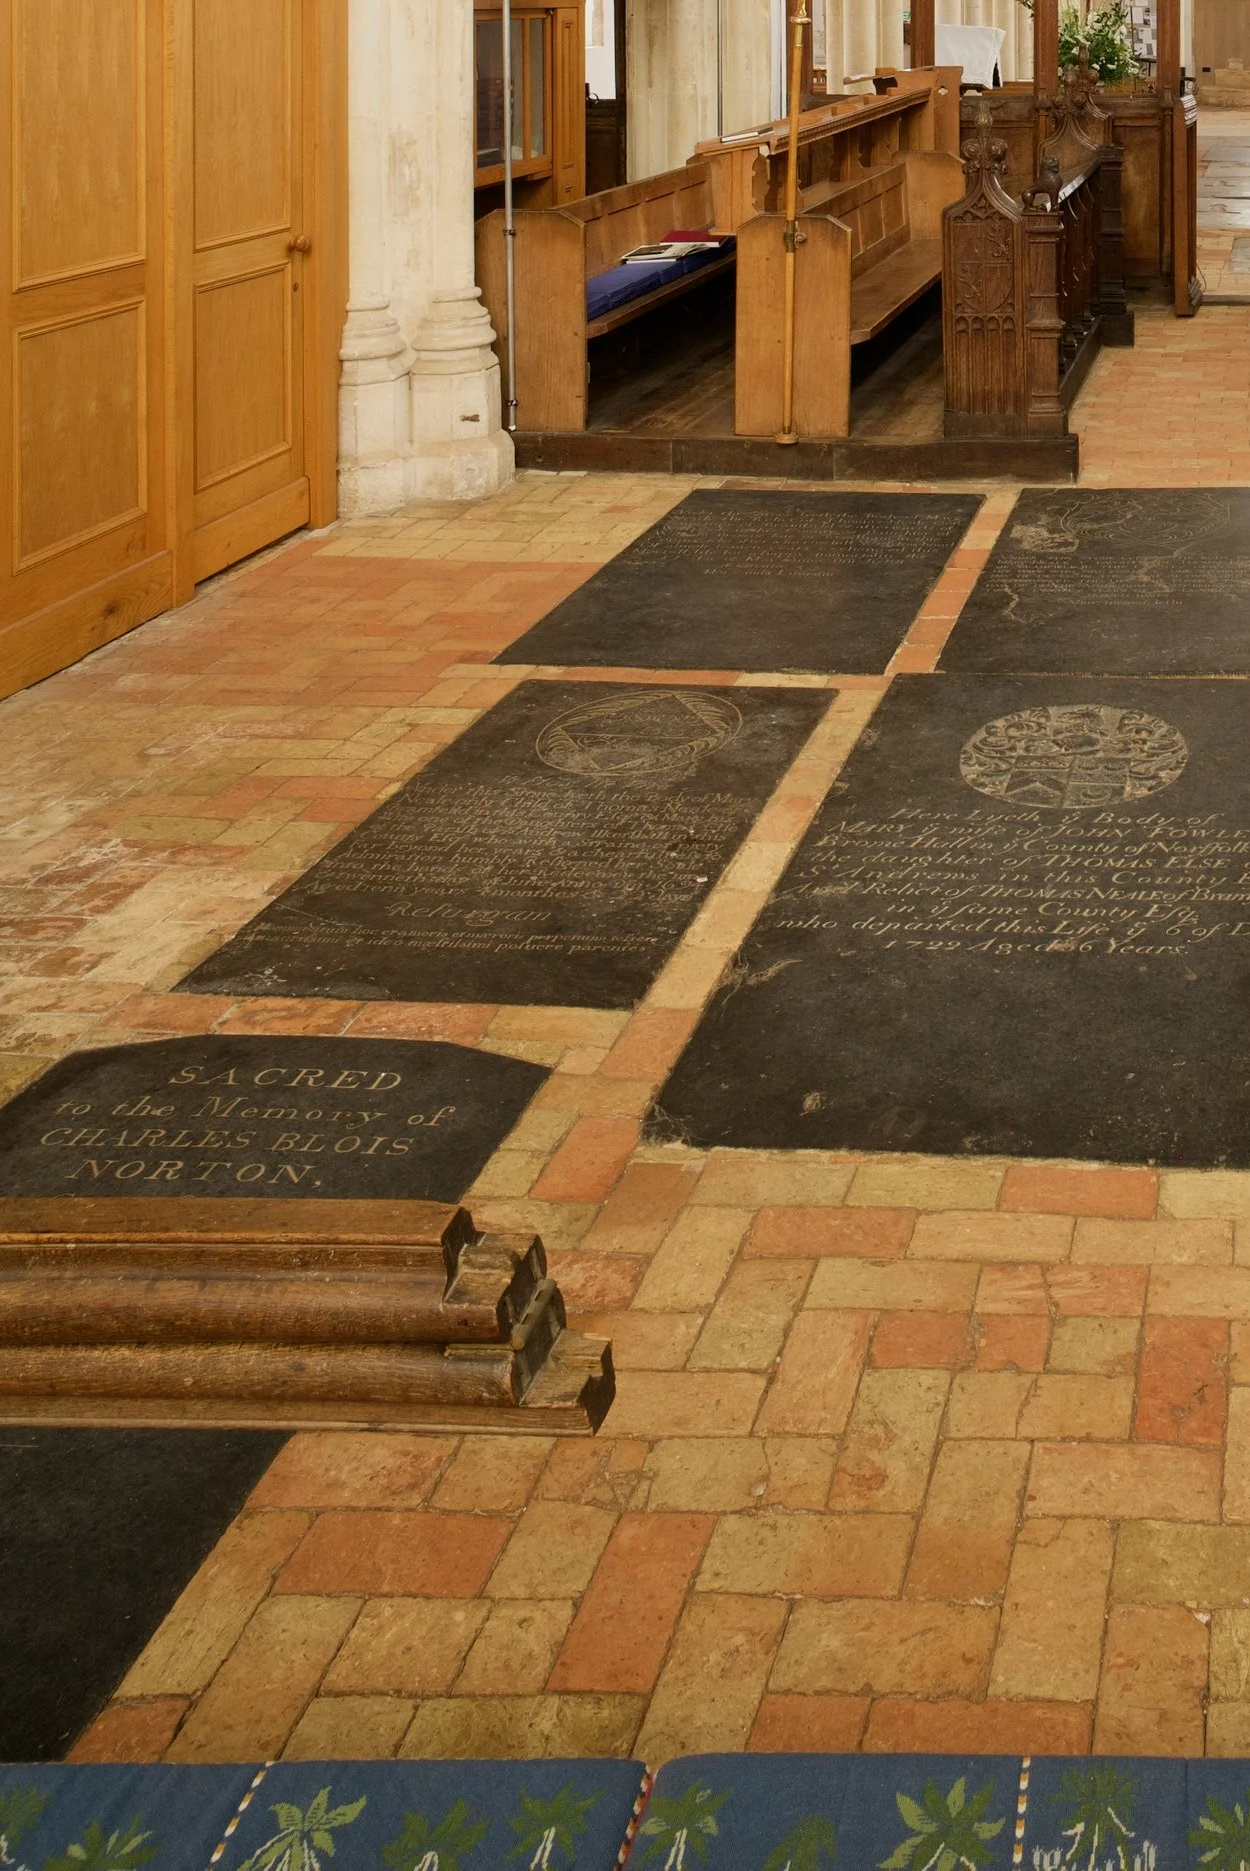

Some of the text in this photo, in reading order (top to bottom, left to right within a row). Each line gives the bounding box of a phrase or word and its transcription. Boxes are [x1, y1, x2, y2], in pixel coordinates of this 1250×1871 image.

[888, 808, 959, 820] Here
[965, 810, 1040, 826] Lyeth
[1091, 812, 1177, 827] Body
[1186, 812, 1224, 828] of
[828, 821, 914, 833] MARY
[949, 824, 1006, 839] wife
[1014, 825, 1052, 841] of
[1042, 825, 1131, 839] JOHN
[1144, 826, 1250, 839] FOWLE
[813, 834, 904, 848] Brome
[906, 835, 972, 849] Hall
[969, 838, 994, 849] in
[1022, 839, 1119, 856] County
[1124, 841, 1156, 857] of
[810, 849, 851, 862] the
[861, 851, 992, 868] daughter
[1001, 854, 1042, 870] of
[1041, 854, 1157, 868] THOMAS
[1164, 856, 1231, 868] ELSE
[833, 865, 980, 881] Andrews
[999, 872, 1030, 882] in
[1043, 870, 1098, 883] this
[1111, 870, 1229, 889] County
[940, 884, 981, 901] of
[978, 883, 1084, 899] THOMAS
[1086, 887, 1163, 900] NEALE
[1162, 889, 1193, 903] of
[885, 899, 916, 913] in
[1037, 901, 1139, 923] County
[773, 913, 838, 929] who
[851, 916, 992, 937] departed
[992, 918, 1048, 934] this
[1049, 920, 1111, 939] Life
[1164, 924, 1189, 936] 6
[1185, 922, 1230, 943] of
[880, 940, 961, 951] 1722
[964, 937, 1055, 955] Aged
[167, 1065, 403, 1091] SACRED
[54, 1095, 457, 1130] to the Memory of
[39, 1127, 416, 1156] CHARLES BLOIS
[63, 1159, 324, 1188] NORTON,
